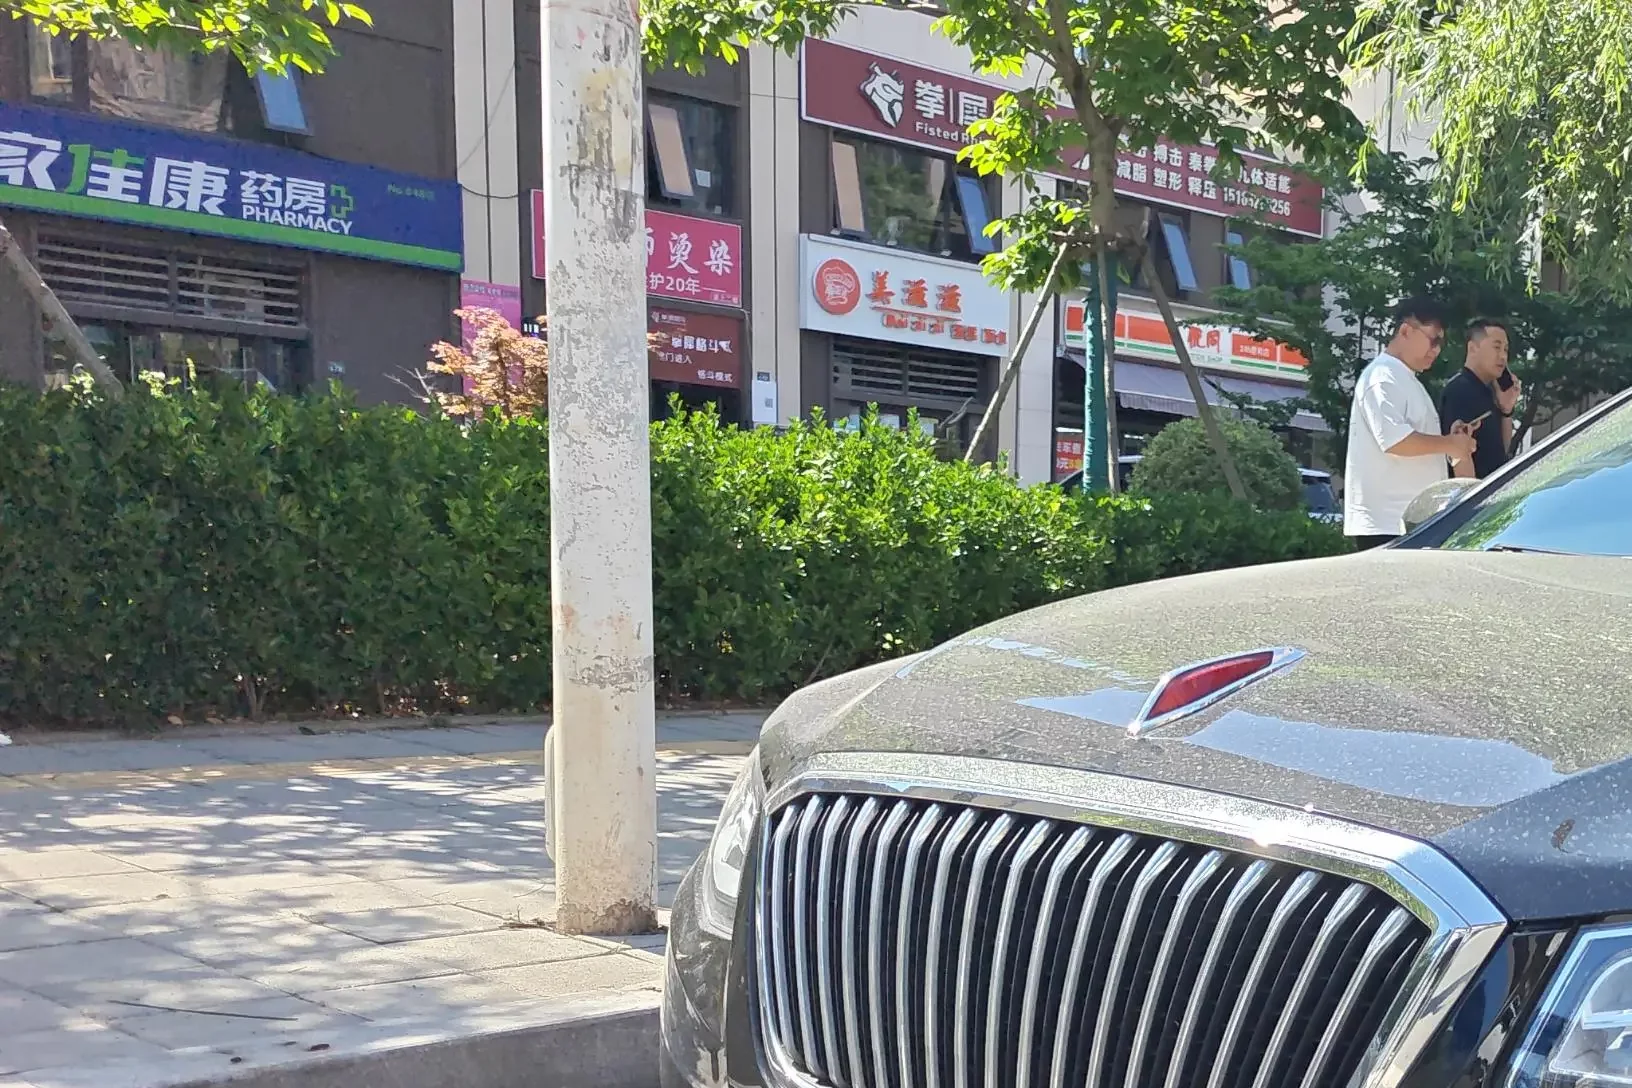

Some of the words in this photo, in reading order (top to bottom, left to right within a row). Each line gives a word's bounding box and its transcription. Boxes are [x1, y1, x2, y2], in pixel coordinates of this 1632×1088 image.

[915, 121, 959, 143] Fisted
[240, 169, 327, 216] 药房
[242, 204, 353, 236] PHARMACY
[645, 272, 701, 296] 护20年
